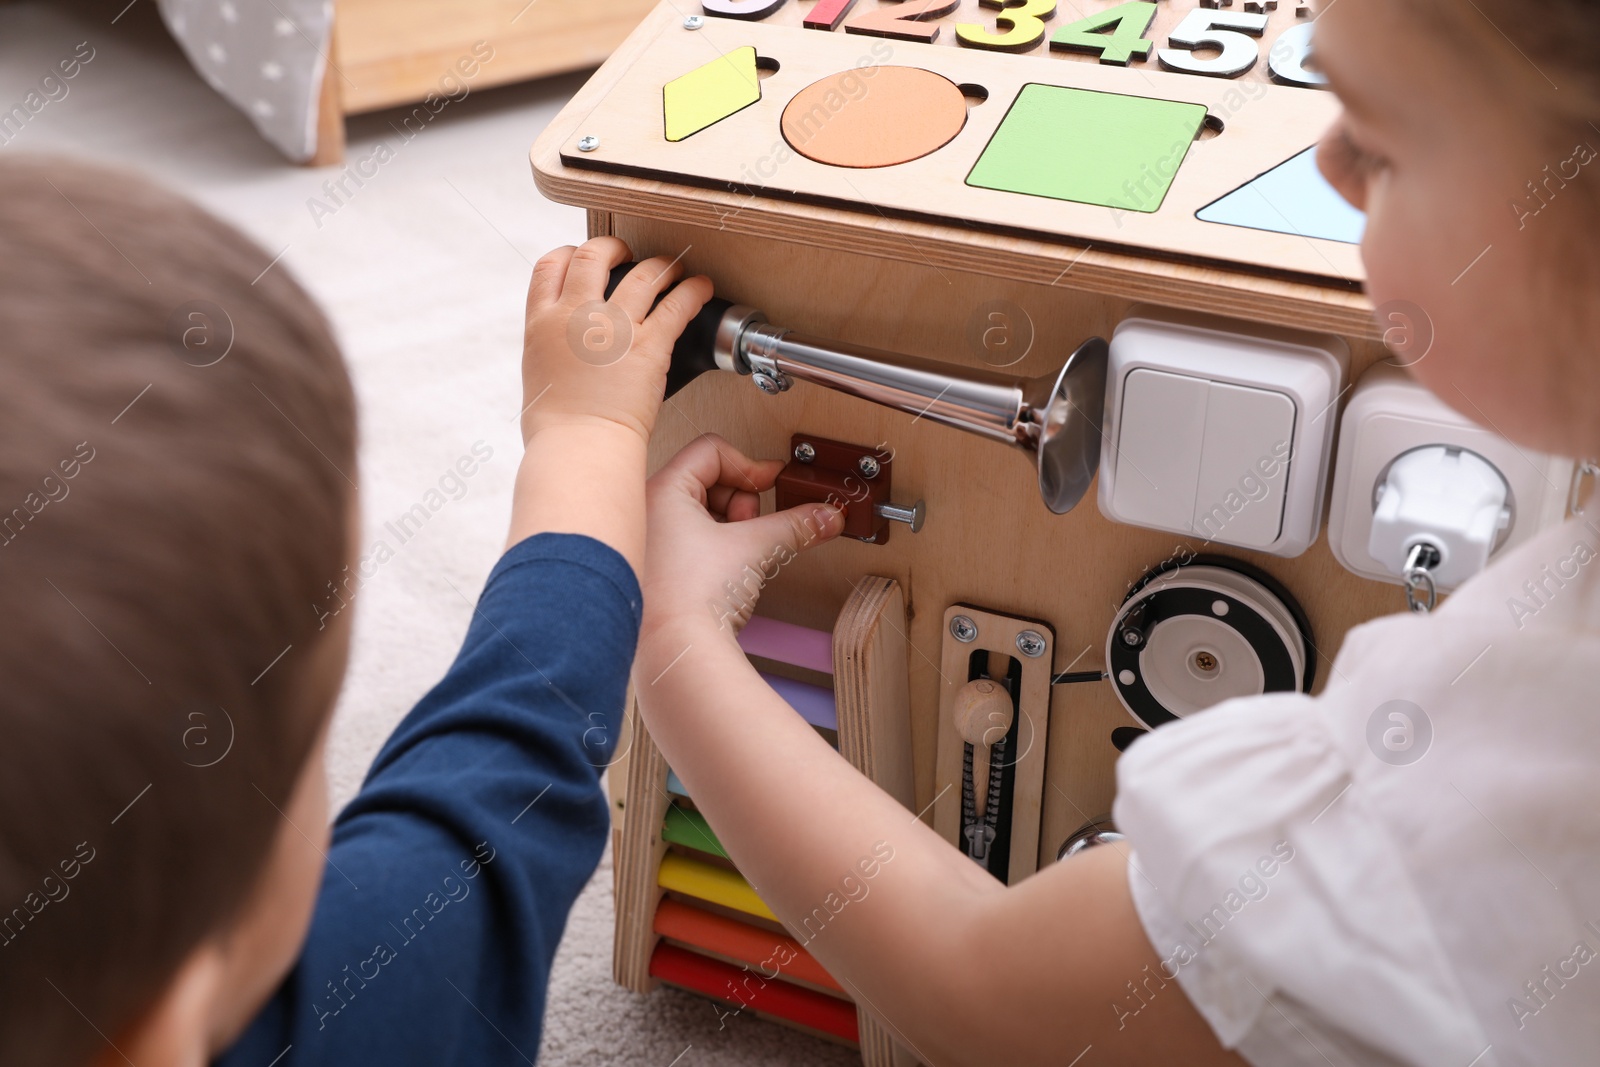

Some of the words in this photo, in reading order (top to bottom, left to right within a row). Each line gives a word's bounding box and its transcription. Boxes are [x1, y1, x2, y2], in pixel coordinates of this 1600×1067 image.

[955, 0, 1058, 54] 3
[1049, 1, 1158, 67] 4
[1157, 8, 1269, 79] 5
